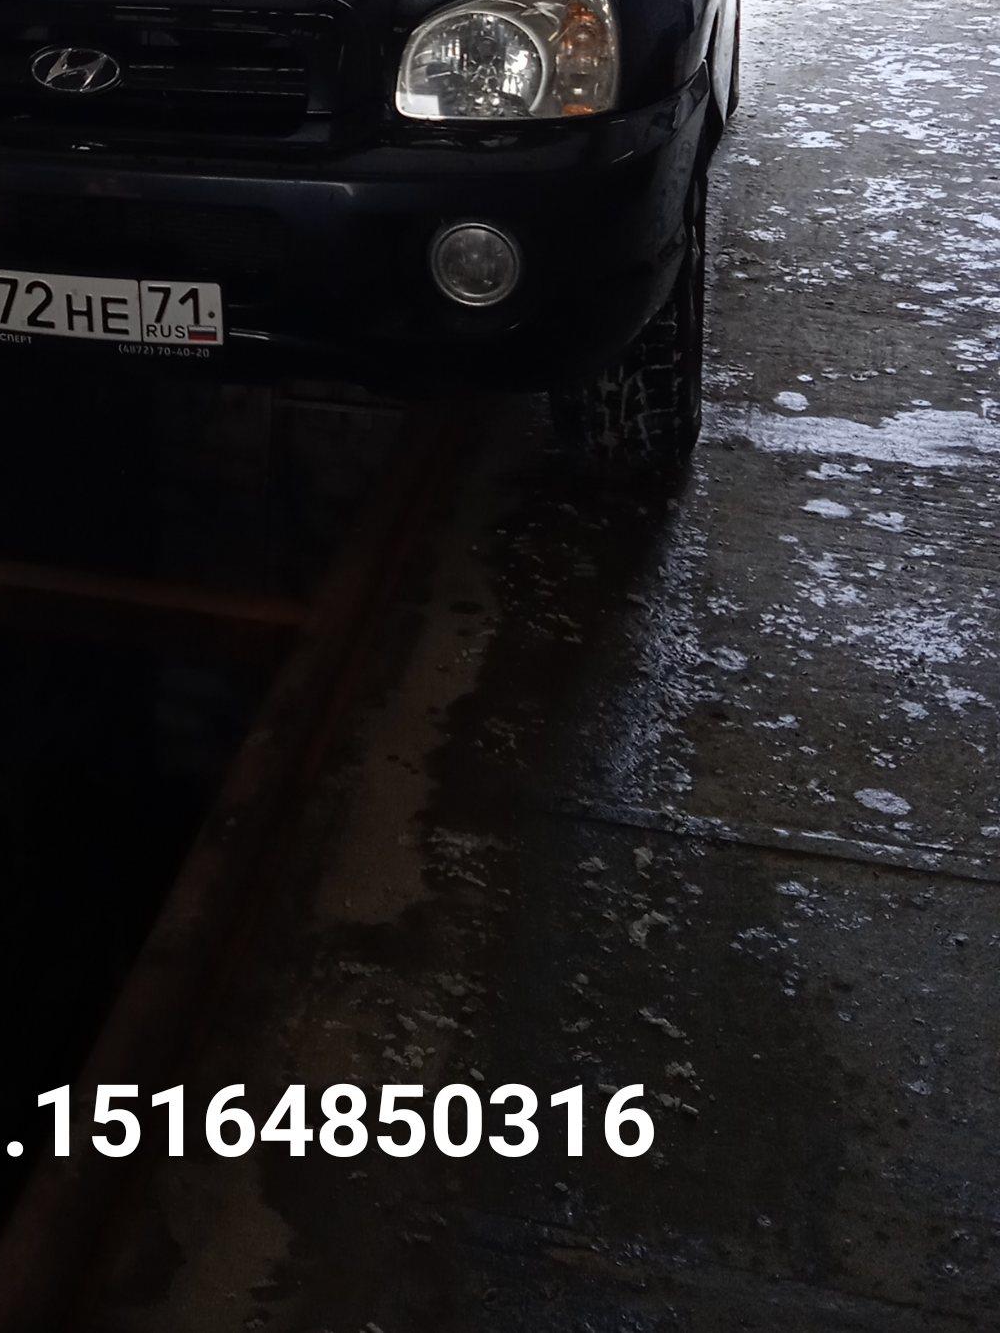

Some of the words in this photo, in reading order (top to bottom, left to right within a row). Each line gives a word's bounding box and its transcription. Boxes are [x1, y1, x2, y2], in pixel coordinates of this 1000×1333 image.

[147, 286, 201, 325] 71
[146, 324, 187, 339] RUS
[157, 346, 210, 358] 70-40-20
